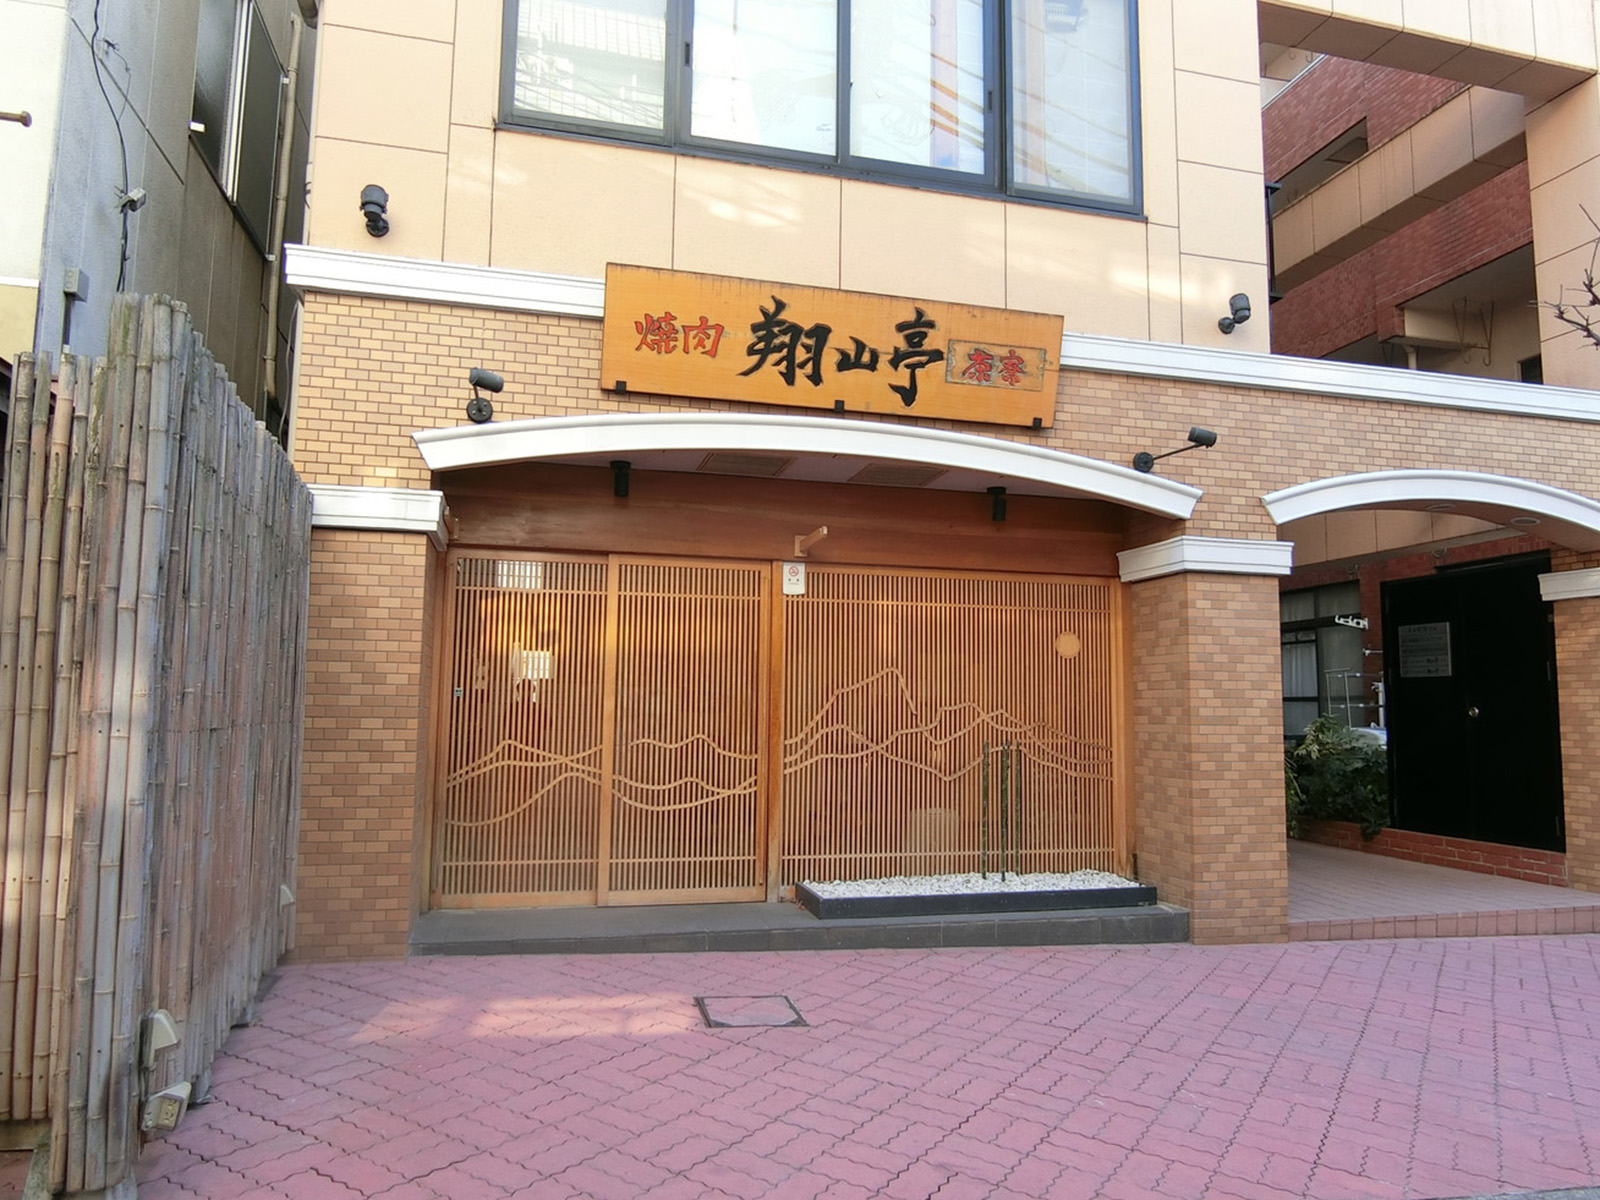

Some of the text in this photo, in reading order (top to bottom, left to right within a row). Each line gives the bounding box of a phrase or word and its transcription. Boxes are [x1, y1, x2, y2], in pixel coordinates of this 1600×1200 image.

[634, 311, 725, 358] 焼肉
[736, 295, 945, 407] 翔山亭
